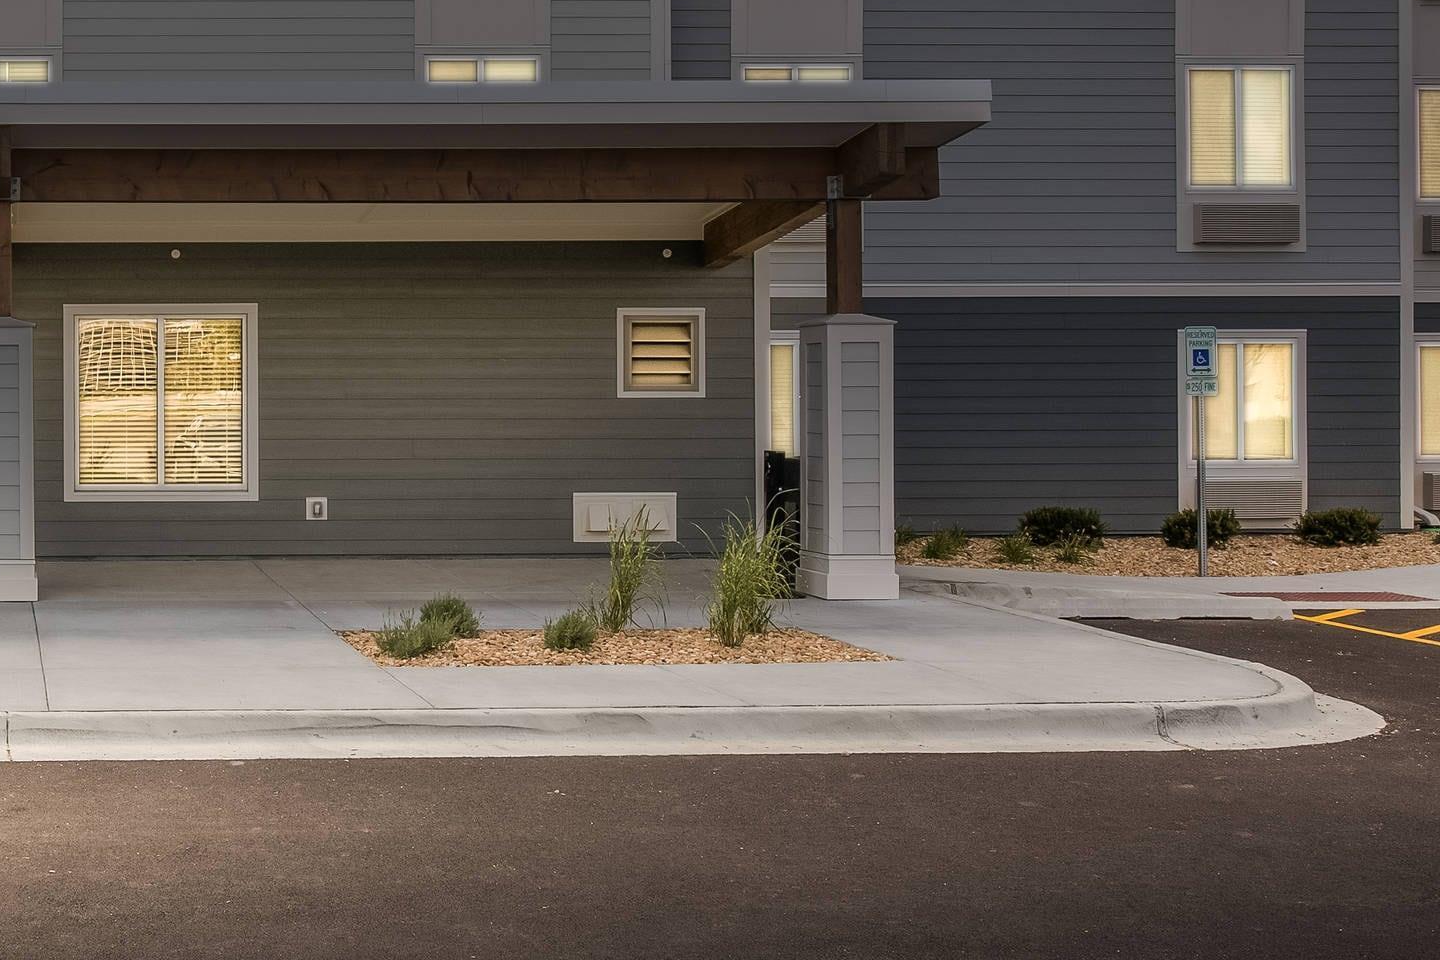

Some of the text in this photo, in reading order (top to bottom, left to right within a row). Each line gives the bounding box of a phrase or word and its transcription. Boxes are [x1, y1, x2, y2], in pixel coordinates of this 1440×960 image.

[1187, 331, 1214, 339] RESERVED
[1188, 340, 1213, 348] PARKING
[1204, 382, 1216, 392] FINE
